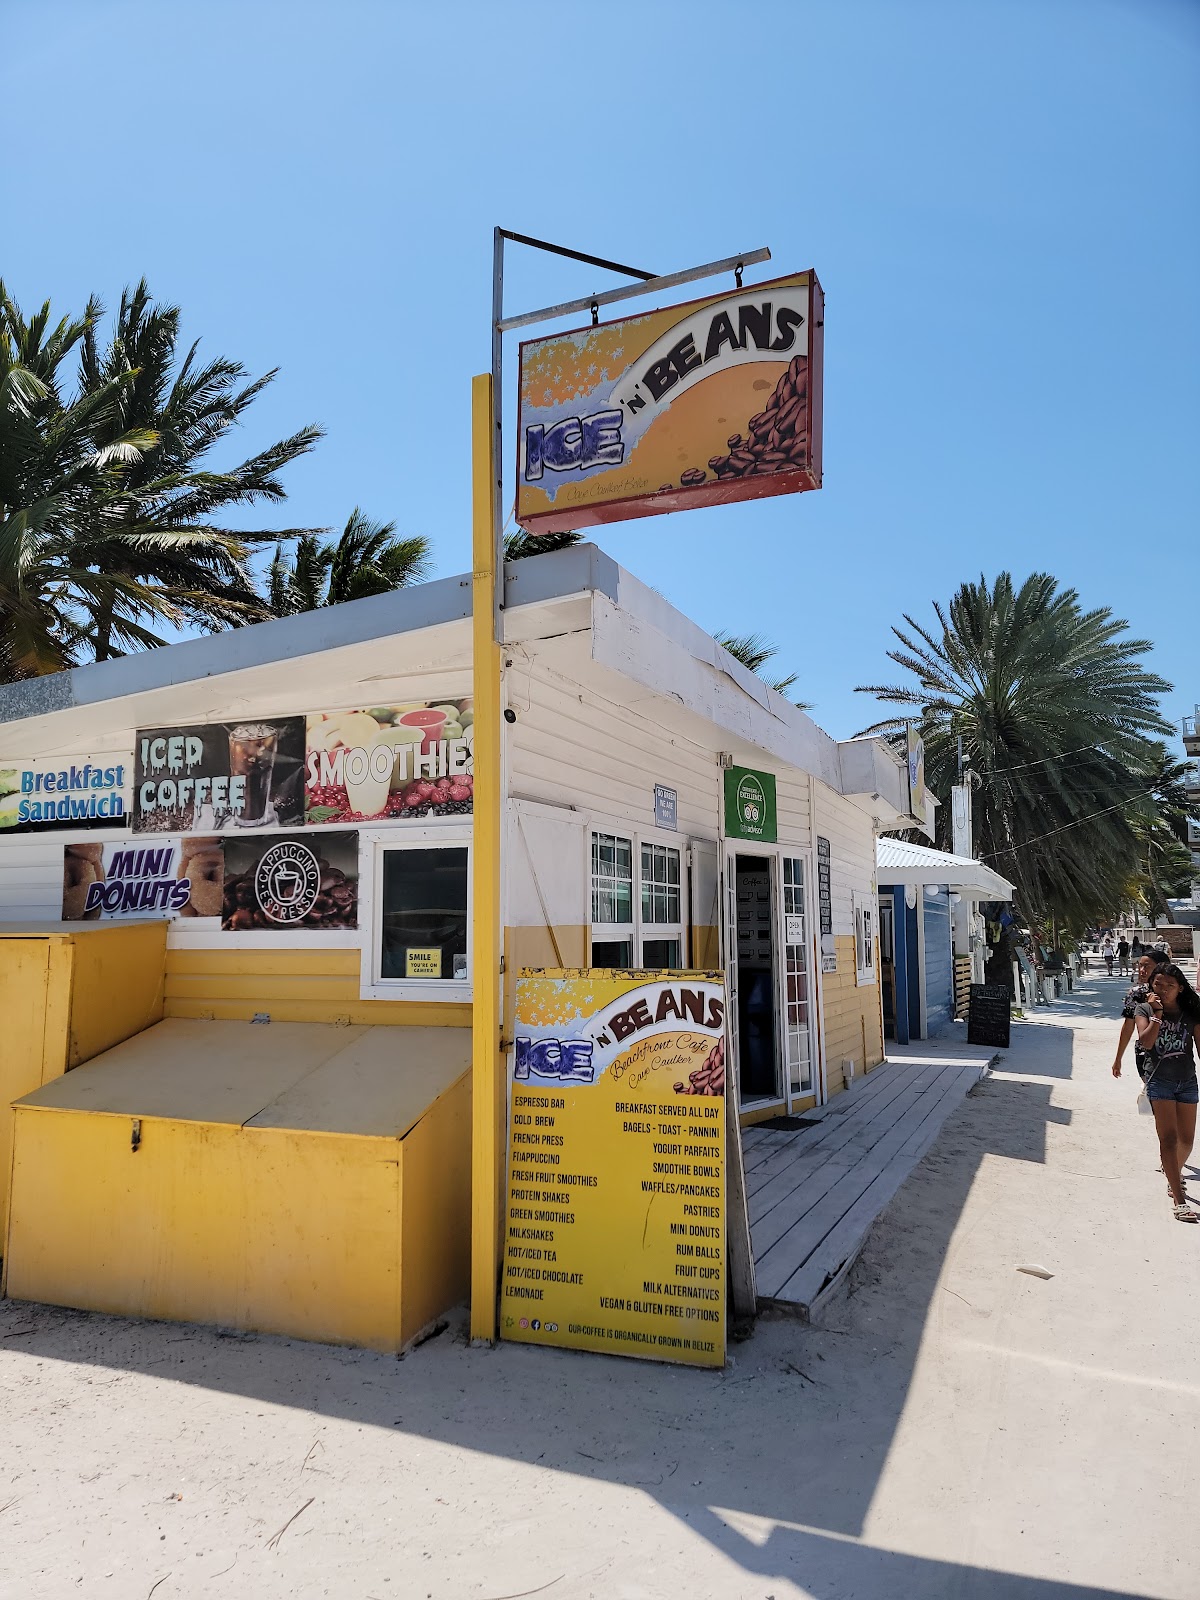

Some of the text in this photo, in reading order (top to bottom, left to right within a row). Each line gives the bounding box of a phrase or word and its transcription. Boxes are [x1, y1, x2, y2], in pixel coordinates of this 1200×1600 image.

[641, 302, 805, 404] BEANS
[525, 409, 625, 481] ICE
[141, 735, 204, 777] ICED
[21, 764, 124, 794] Breakfast
[139, 774, 247, 820] COFFEE
[106, 847, 173, 880] MINI
[259, 846, 317, 882] CAPPUCCINO
[84, 878, 191, 912] DONUTS
[260, 889, 316, 920] ESPRESSO
[409, 953, 431, 961] SMILE
[608, 988, 724, 1042] BEANS
[514, 1037, 595, 1083] ICE
[610, 1034, 709, 1082] Beachfront Cafe
[628, 1054, 693, 1089] Caye Caulker
[515, 1096, 565, 1109] ESPRESSO BAR
[615, 1102, 719, 1119] BREAKFAST SERVED ALL DAY
[514, 1114, 555, 1127] COLD BREW
[623, 1121, 651, 1133] BAGELS
[658, 1124, 681, 1136] TOAST
[688, 1126, 720, 1138] PANNINI
[513, 1132, 564, 1146] FRENCH PRESS
[653, 1142, 720, 1158] YOGURT PARFAITS
[512, 1170, 598, 1187] FRESH FRUIT SMOOTHIES
[652, 1162, 720, 1178] SMOOTHIE BOWLS
[511, 1189, 570, 1204] PROTEIN SHAKES
[641, 1180, 720, 1198] WAFFLES/PANCAKES
[510, 1208, 575, 1224] GREEN SMOOTHIES
[683, 1204, 720, 1218] PASTRIES
[509, 1227, 554, 1241] MILKSHAKES
[670, 1223, 720, 1239] MINI DONUTS
[508, 1246, 557, 1262] HOT/ICED TEA
[676, 1244, 720, 1259] RUM BALLS
[506, 1265, 584, 1285] HOT/ICED CHOCOLATE
[675, 1264, 720, 1280] FRUIT CUPS
[505, 1285, 544, 1300] LEMONADE
[643, 1281, 720, 1301] MILK ALTERNATIVES
[600, 1296, 719, 1323] VEGAN & GLUTEN FREE OPTIONS
[568, 1324, 715, 1353] OUR COFFEE IS ORGANICALLY GROWN IN BELIZE
